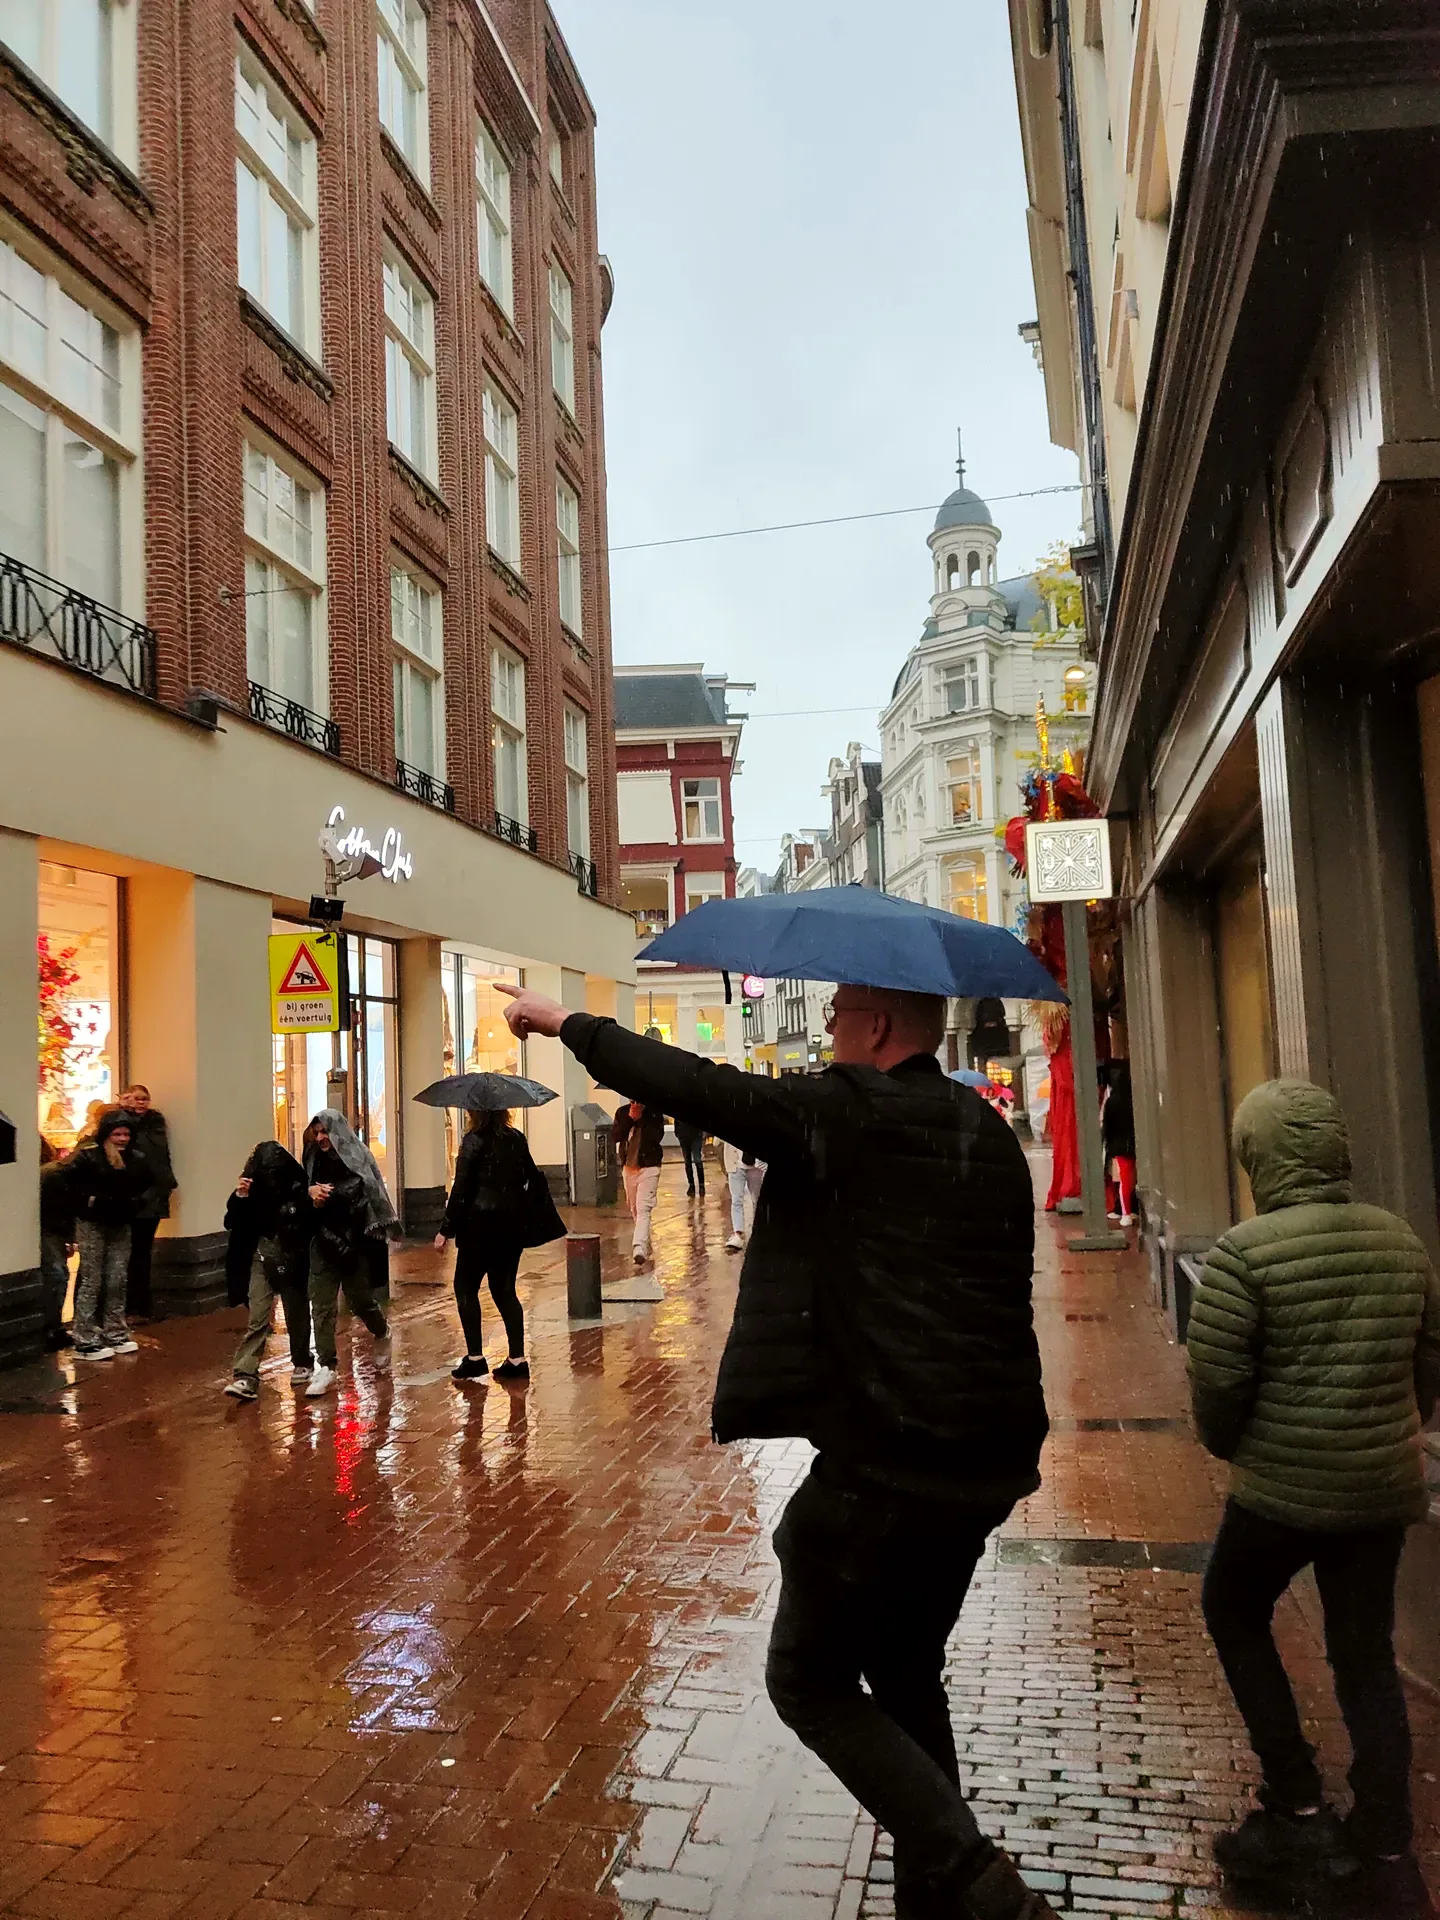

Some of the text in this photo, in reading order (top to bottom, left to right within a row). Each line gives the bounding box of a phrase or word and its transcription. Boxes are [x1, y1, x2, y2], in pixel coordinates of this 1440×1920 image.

[286, 1002, 324, 1013] bij groen
[279, 1012, 332, 1023] één voertuig
